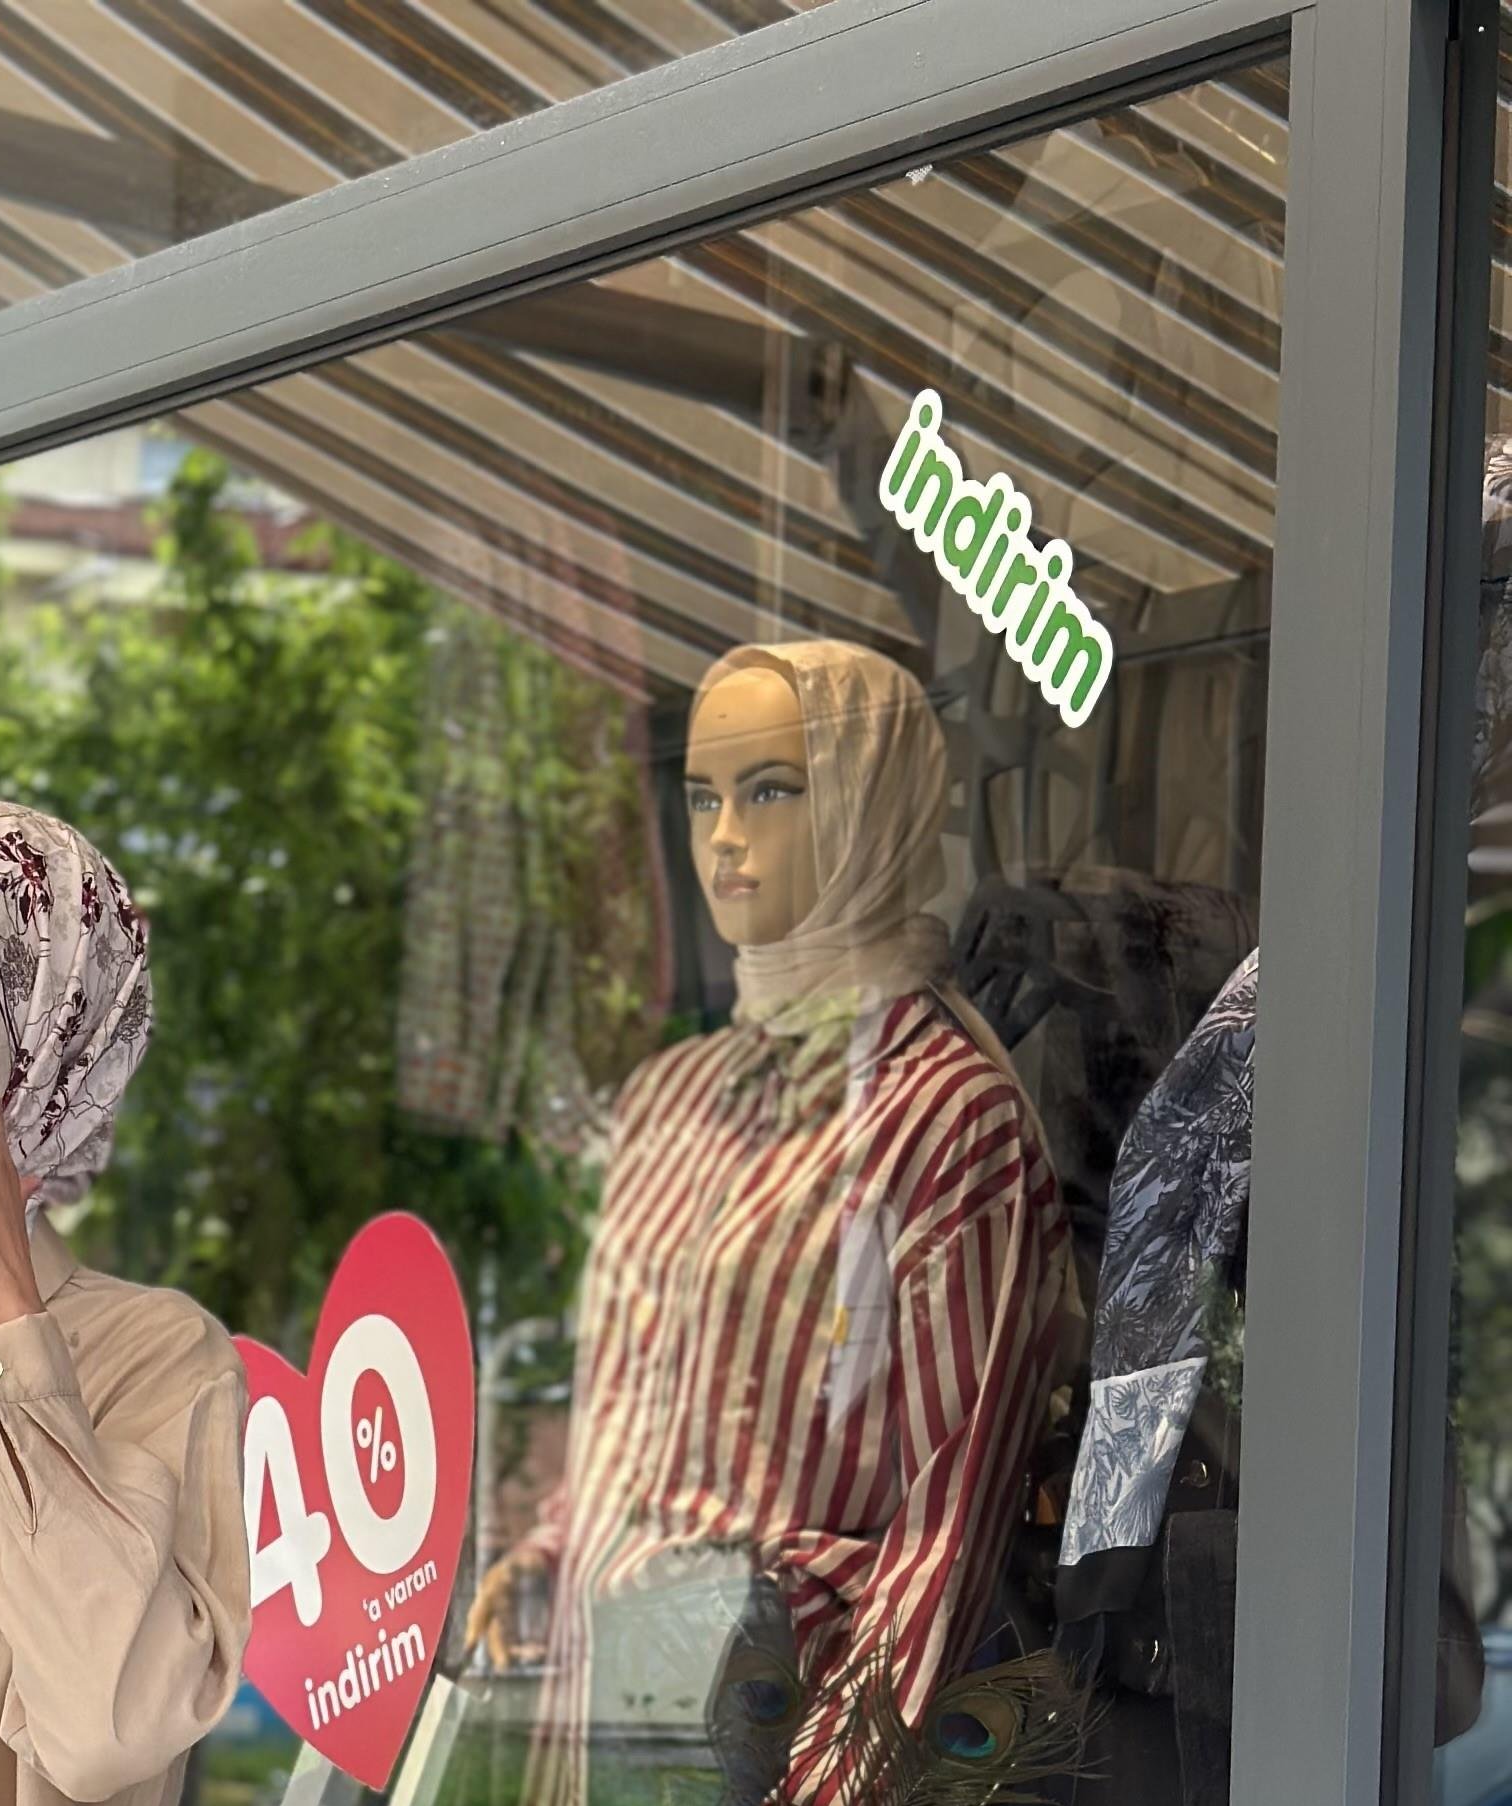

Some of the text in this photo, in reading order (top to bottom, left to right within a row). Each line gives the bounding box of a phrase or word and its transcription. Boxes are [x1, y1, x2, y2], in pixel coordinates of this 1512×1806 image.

[888, 404, 1103, 712] indirim
[244, 1313, 437, 1628] 40
[304, 1622, 426, 1731] indirim
[384, 1559, 438, 1611] varan
